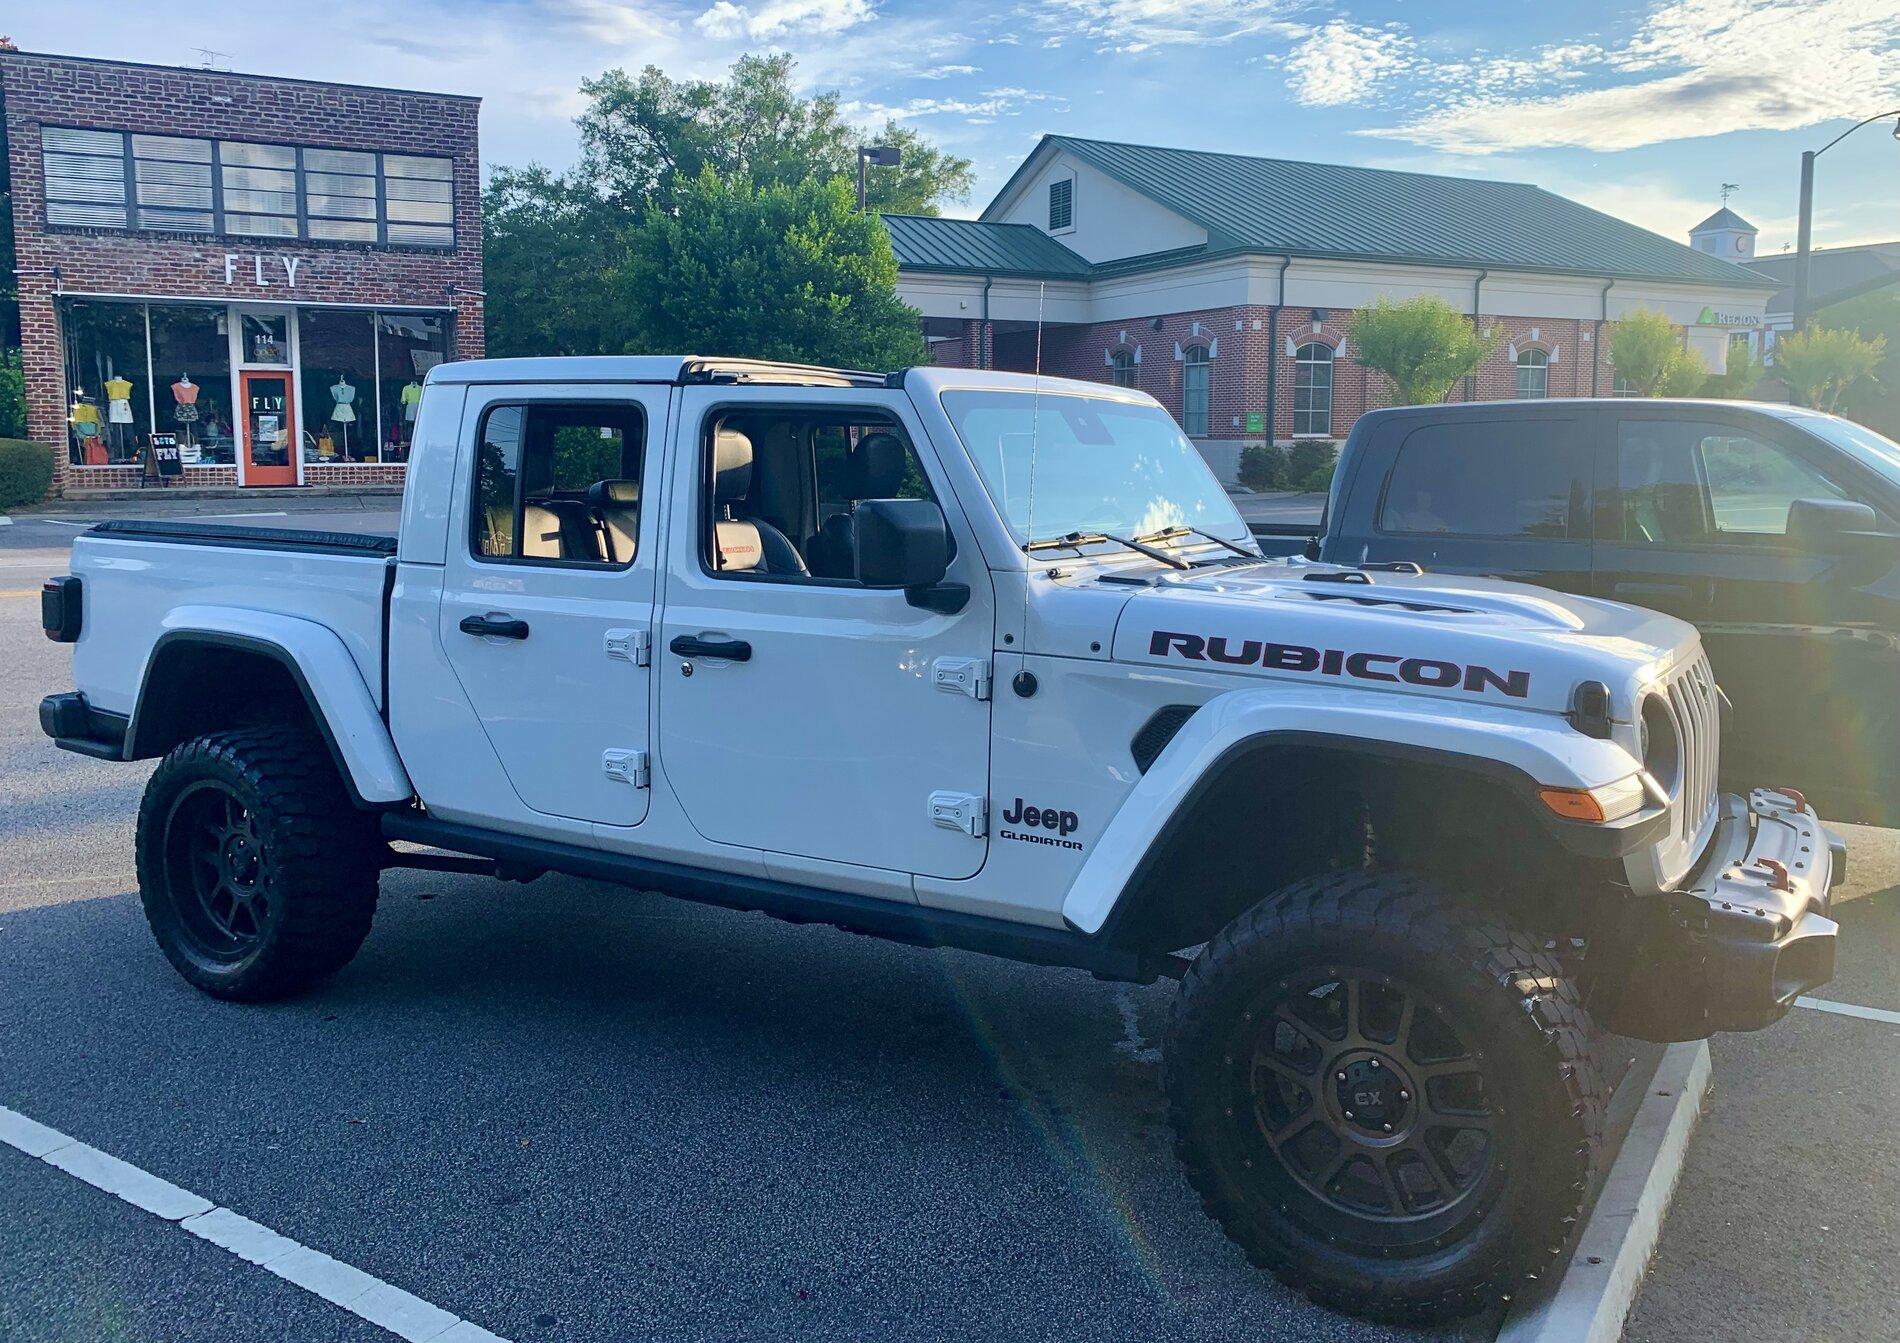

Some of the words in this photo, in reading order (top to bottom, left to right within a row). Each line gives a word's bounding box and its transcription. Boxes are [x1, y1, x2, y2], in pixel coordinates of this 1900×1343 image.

[225, 253, 300, 288] FLY
[254, 334, 274, 344] 114
[252, 397, 282, 410] FLY
[155, 448, 178, 461] FLY
[1148, 629, 1531, 699] RUBICON
[1003, 797, 1079, 837] Jeep
[1000, 829, 1084, 851] GLADIATOR
